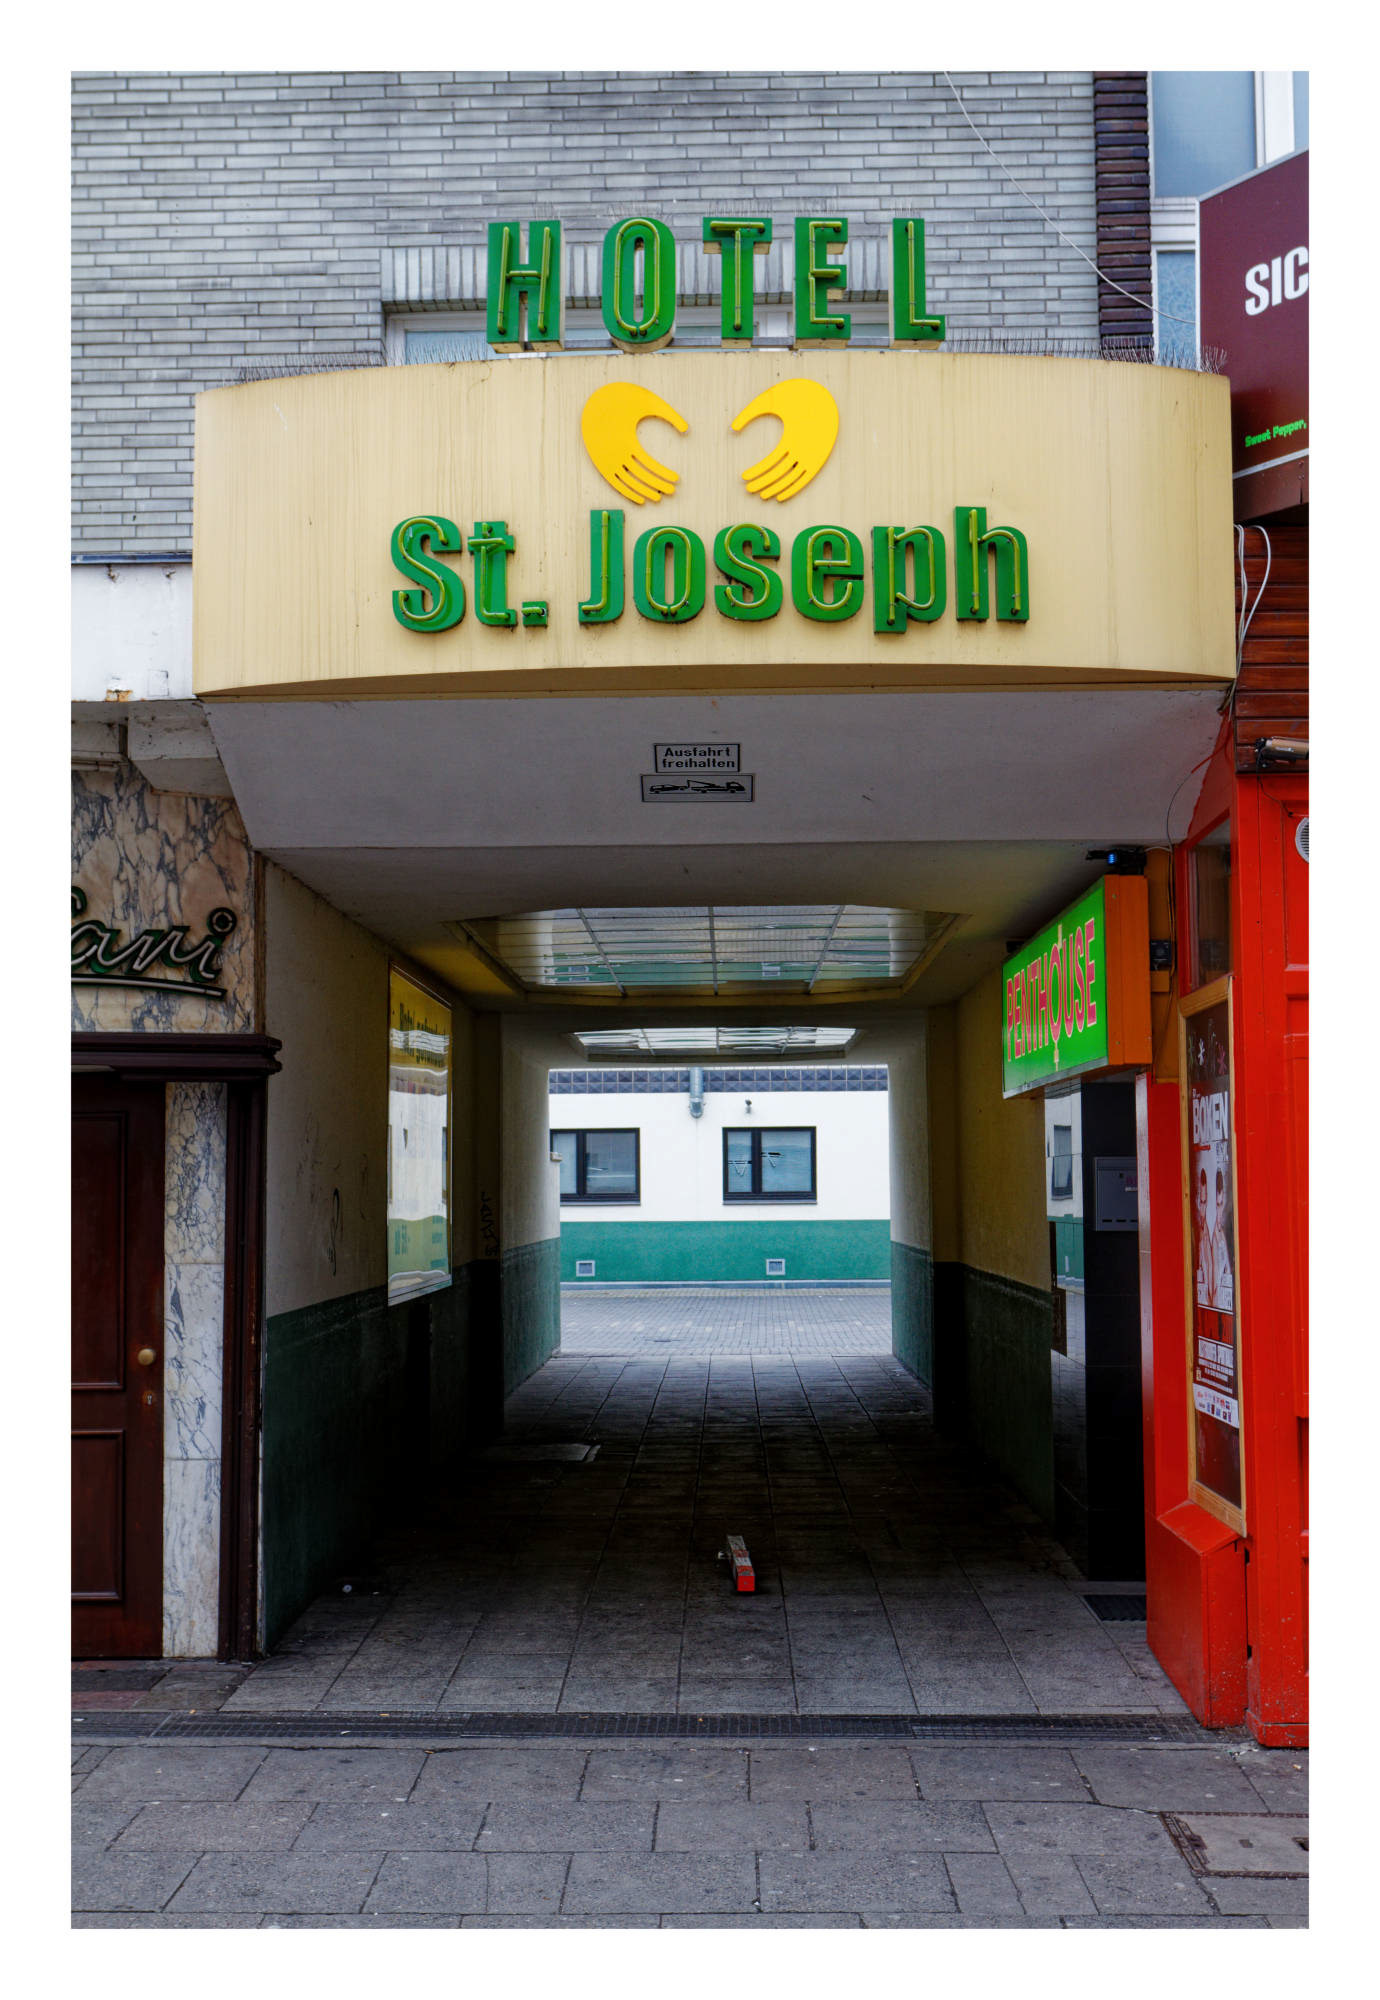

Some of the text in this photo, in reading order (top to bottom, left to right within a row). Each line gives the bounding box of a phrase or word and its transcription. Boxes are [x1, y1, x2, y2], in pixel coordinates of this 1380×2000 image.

[487, 217, 946, 350] HOTEL
[1245, 245, 1309, 316] SIC
[1244, 428, 1271, 447] Sweet
[391, 506, 1030, 634] St. Joseph
[662, 758, 735, 768] freihalten
[664, 746, 730, 757] Ausfahrt
[1006, 916, 1097, 1063] PENTHOUSE
[1192, 1090, 1229, 1144] BOXEN
